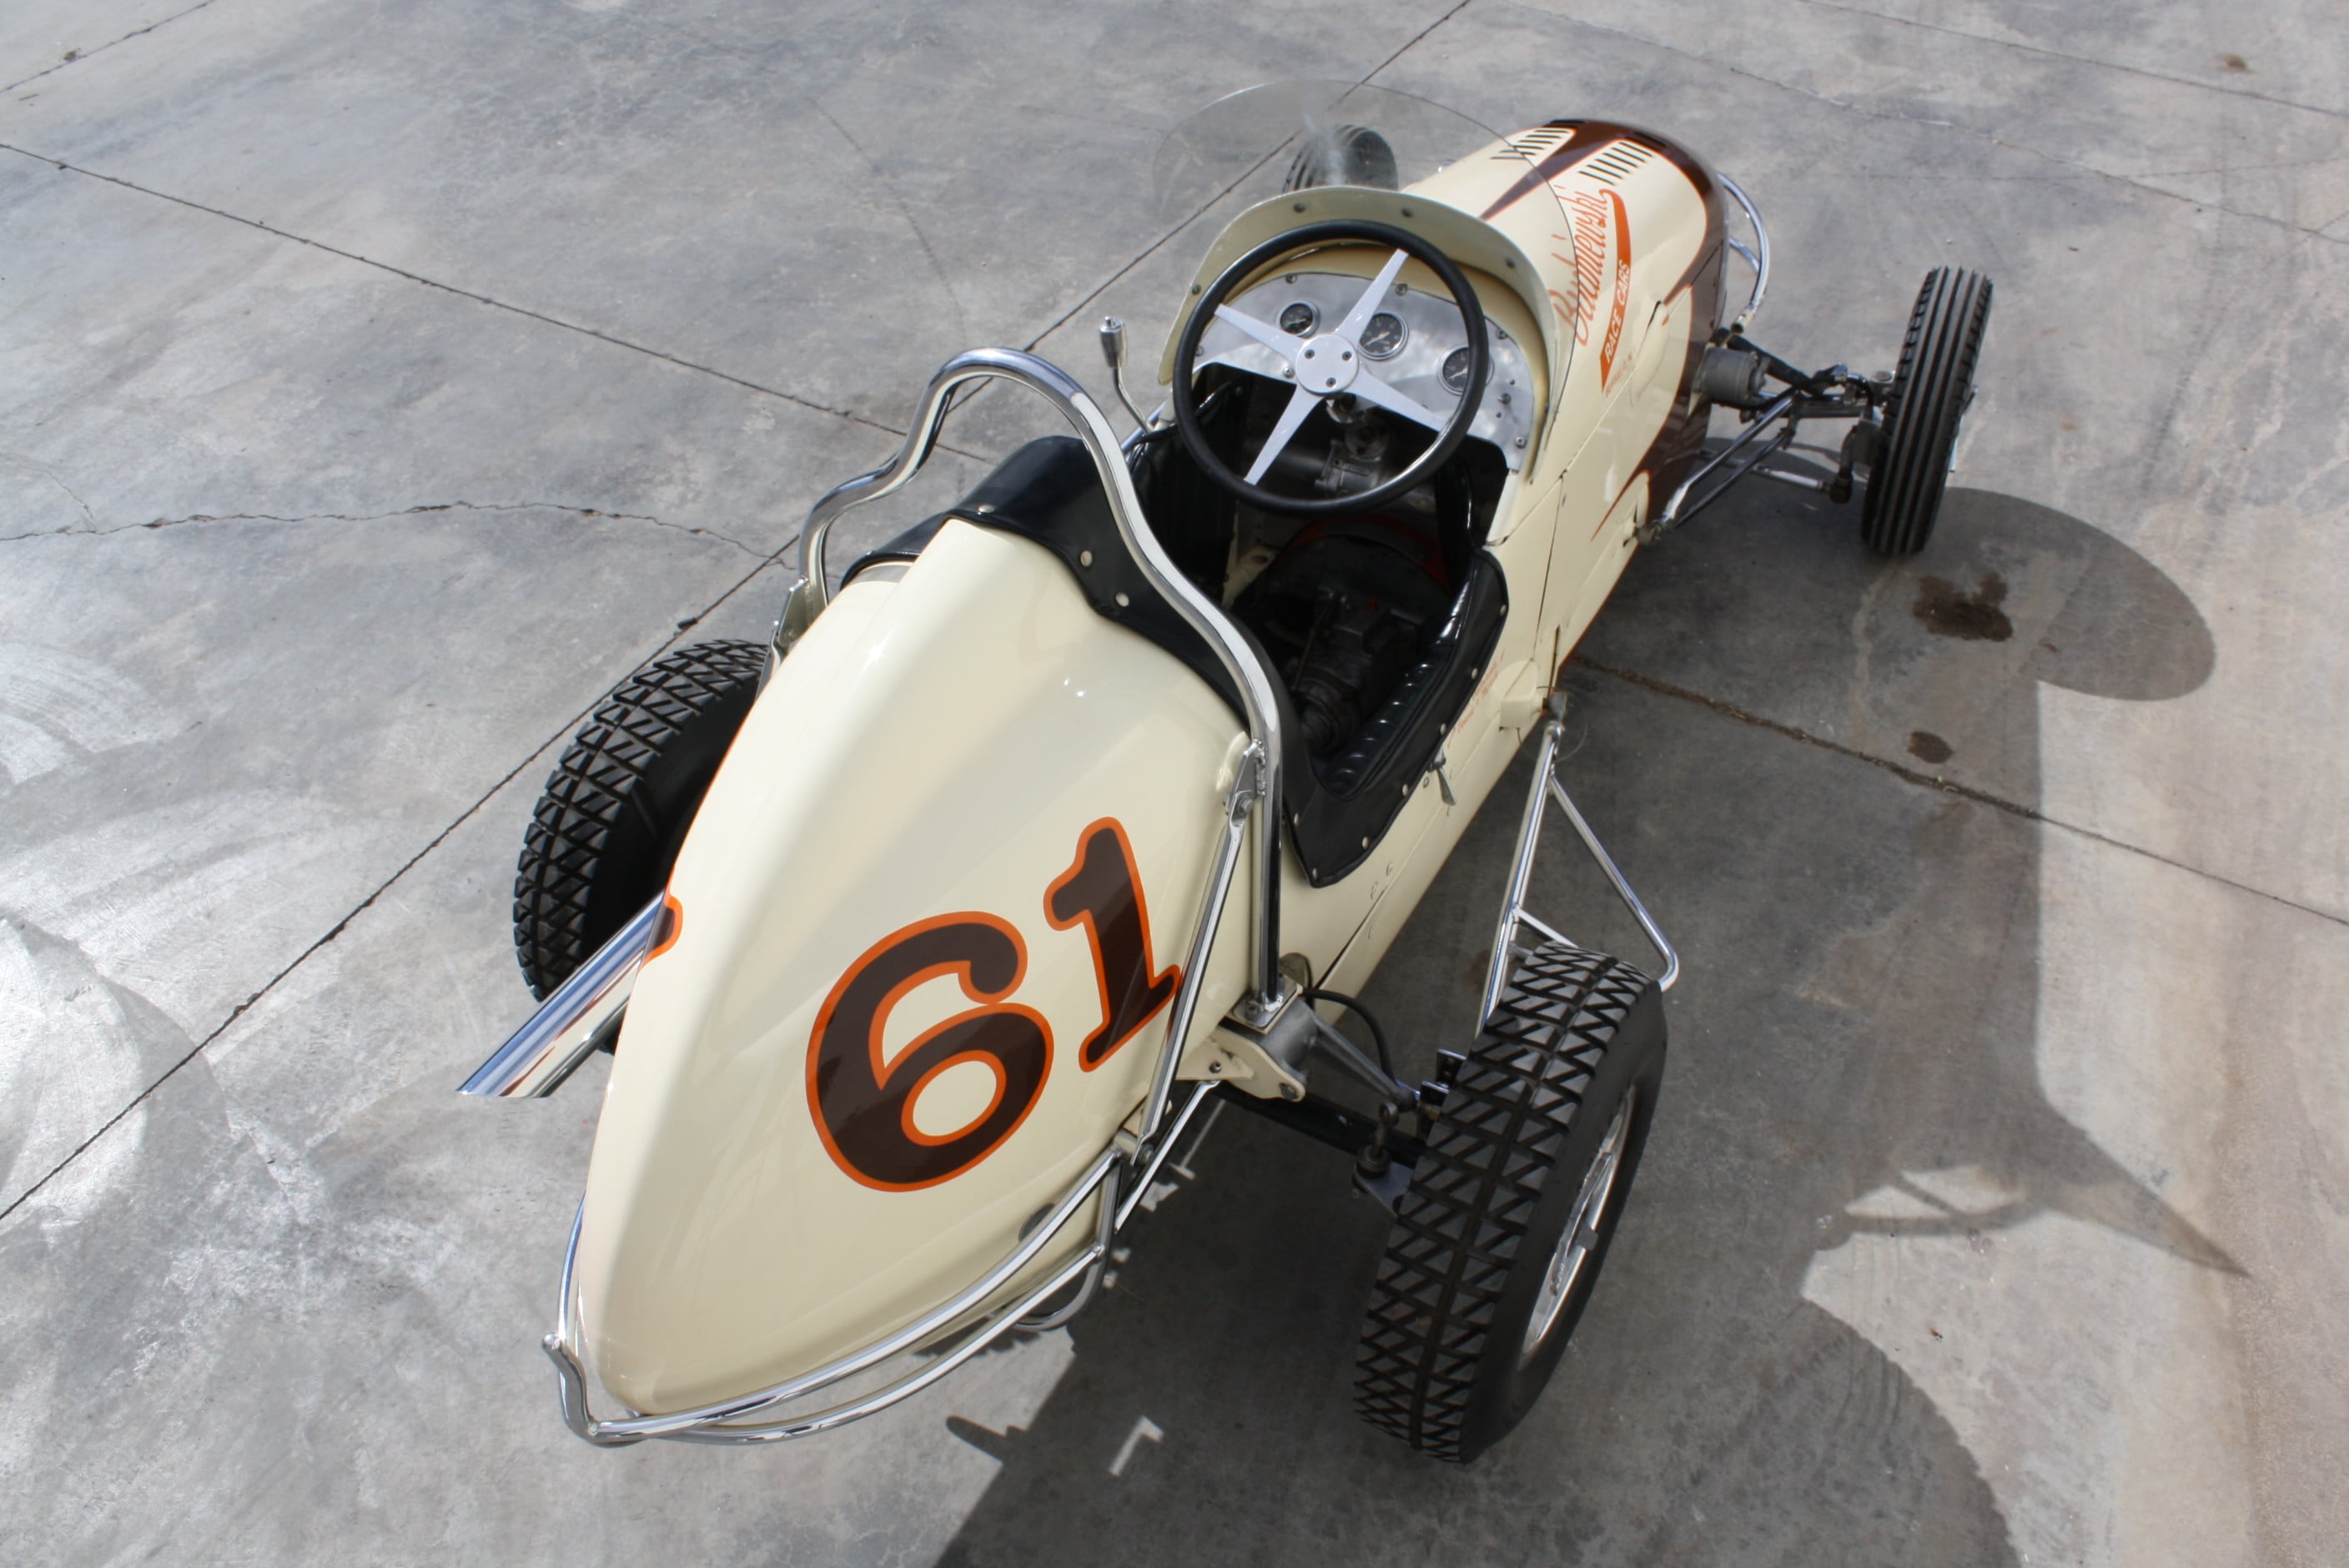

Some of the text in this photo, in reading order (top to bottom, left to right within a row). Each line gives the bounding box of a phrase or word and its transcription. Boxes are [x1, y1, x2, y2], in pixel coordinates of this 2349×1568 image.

[1605, 309, 1622, 363] RACE
[1616, 260, 1630, 306] CARS
[805, 817, 1181, 1193] 61
